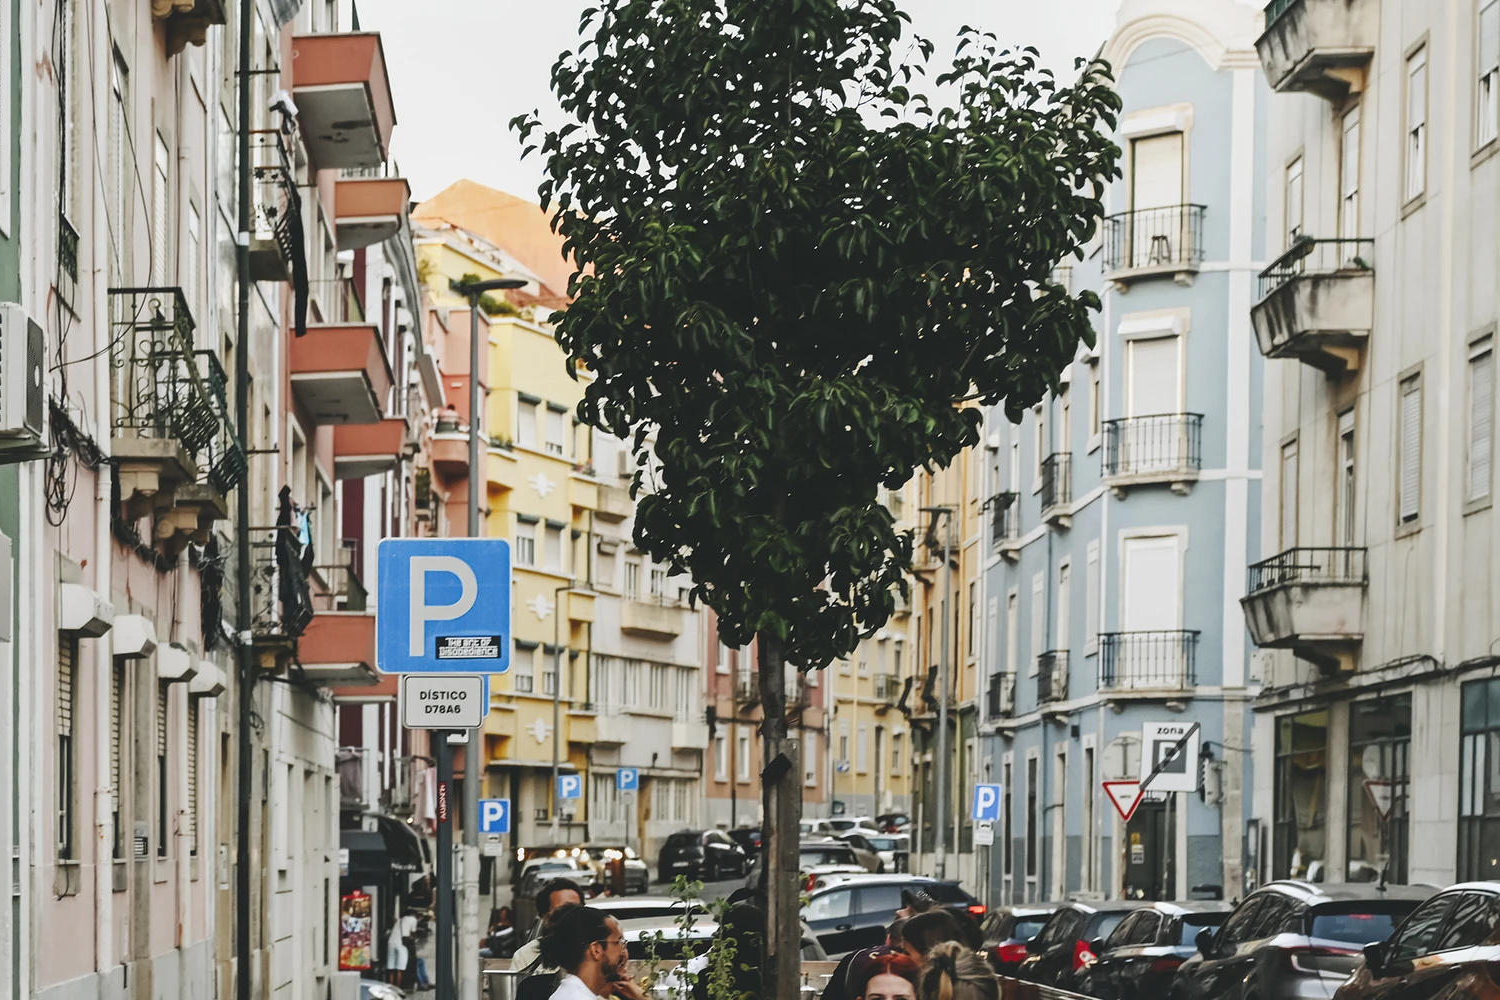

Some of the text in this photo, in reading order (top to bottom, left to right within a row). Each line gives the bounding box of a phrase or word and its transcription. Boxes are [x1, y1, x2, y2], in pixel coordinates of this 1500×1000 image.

[409, 556, 478, 657] P
[420, 689, 467, 700] DÍSTICO
[425, 704, 461, 714] D78A6
[1157, 727, 1184, 735] zona
[562, 777, 577, 797] P
[621, 770, 634, 788] P
[977, 787, 995, 818] P
[483, 801, 504, 832] P
